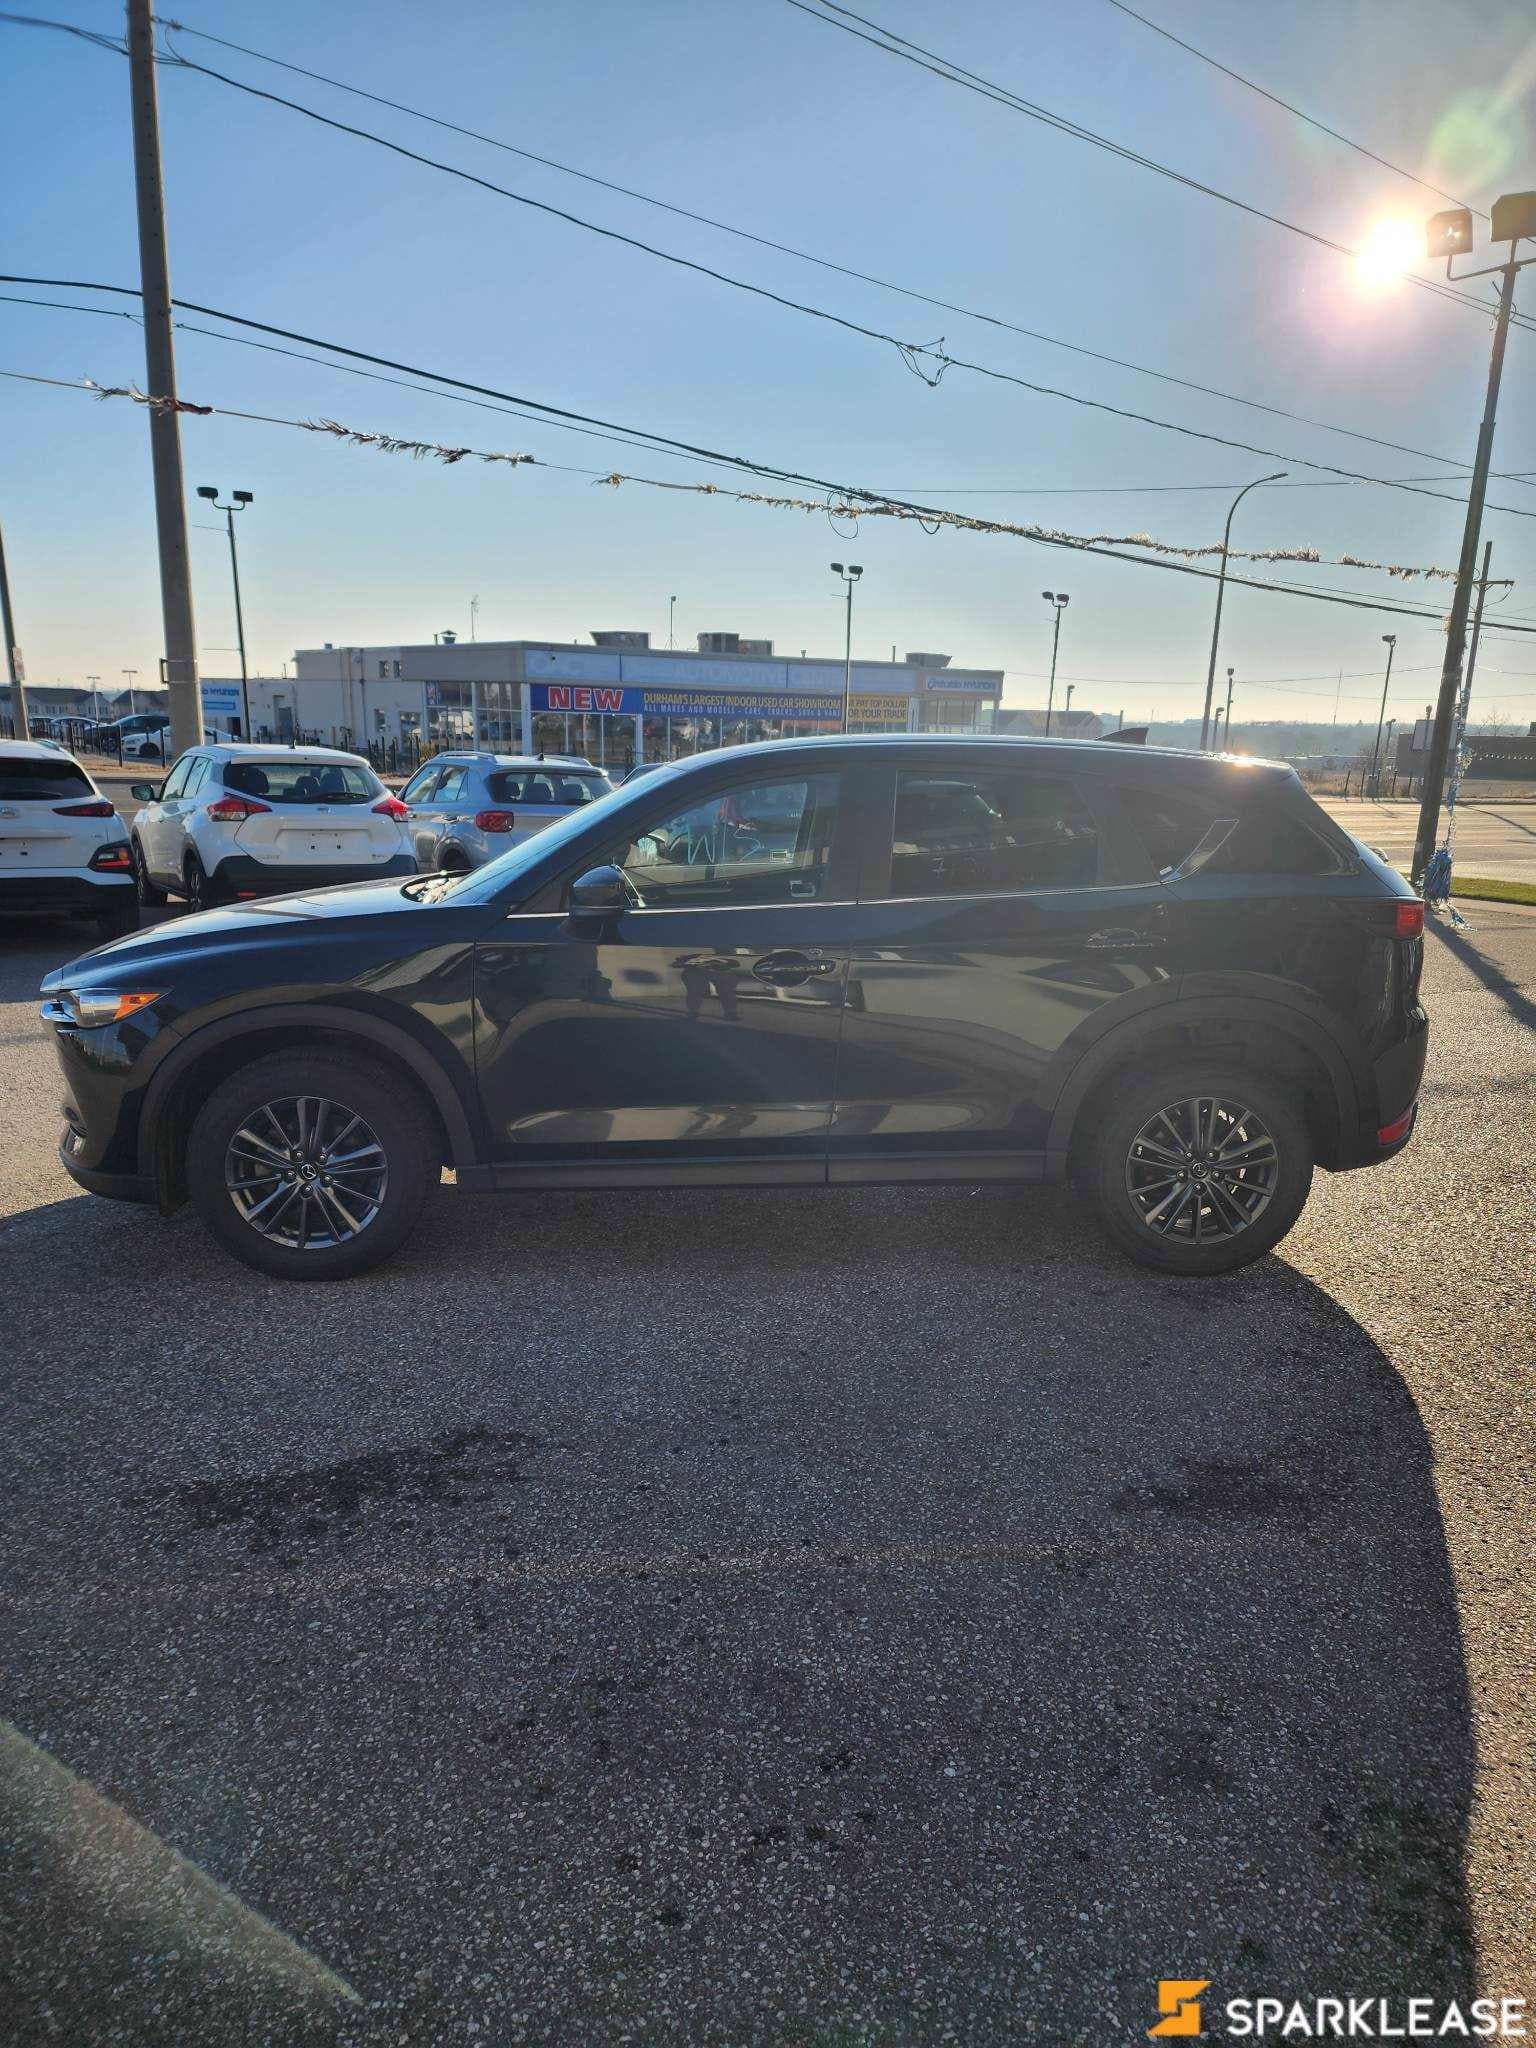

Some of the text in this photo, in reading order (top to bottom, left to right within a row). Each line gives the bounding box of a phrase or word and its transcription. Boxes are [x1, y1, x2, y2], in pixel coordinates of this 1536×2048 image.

[548, 686, 624, 711] NEW
[643, 692, 841, 709] DURHAM'S LARGEST INDOOR USED CAR SHOWROOM
[660, 704, 685, 713] MAKES
[688, 705, 703, 713] AND
